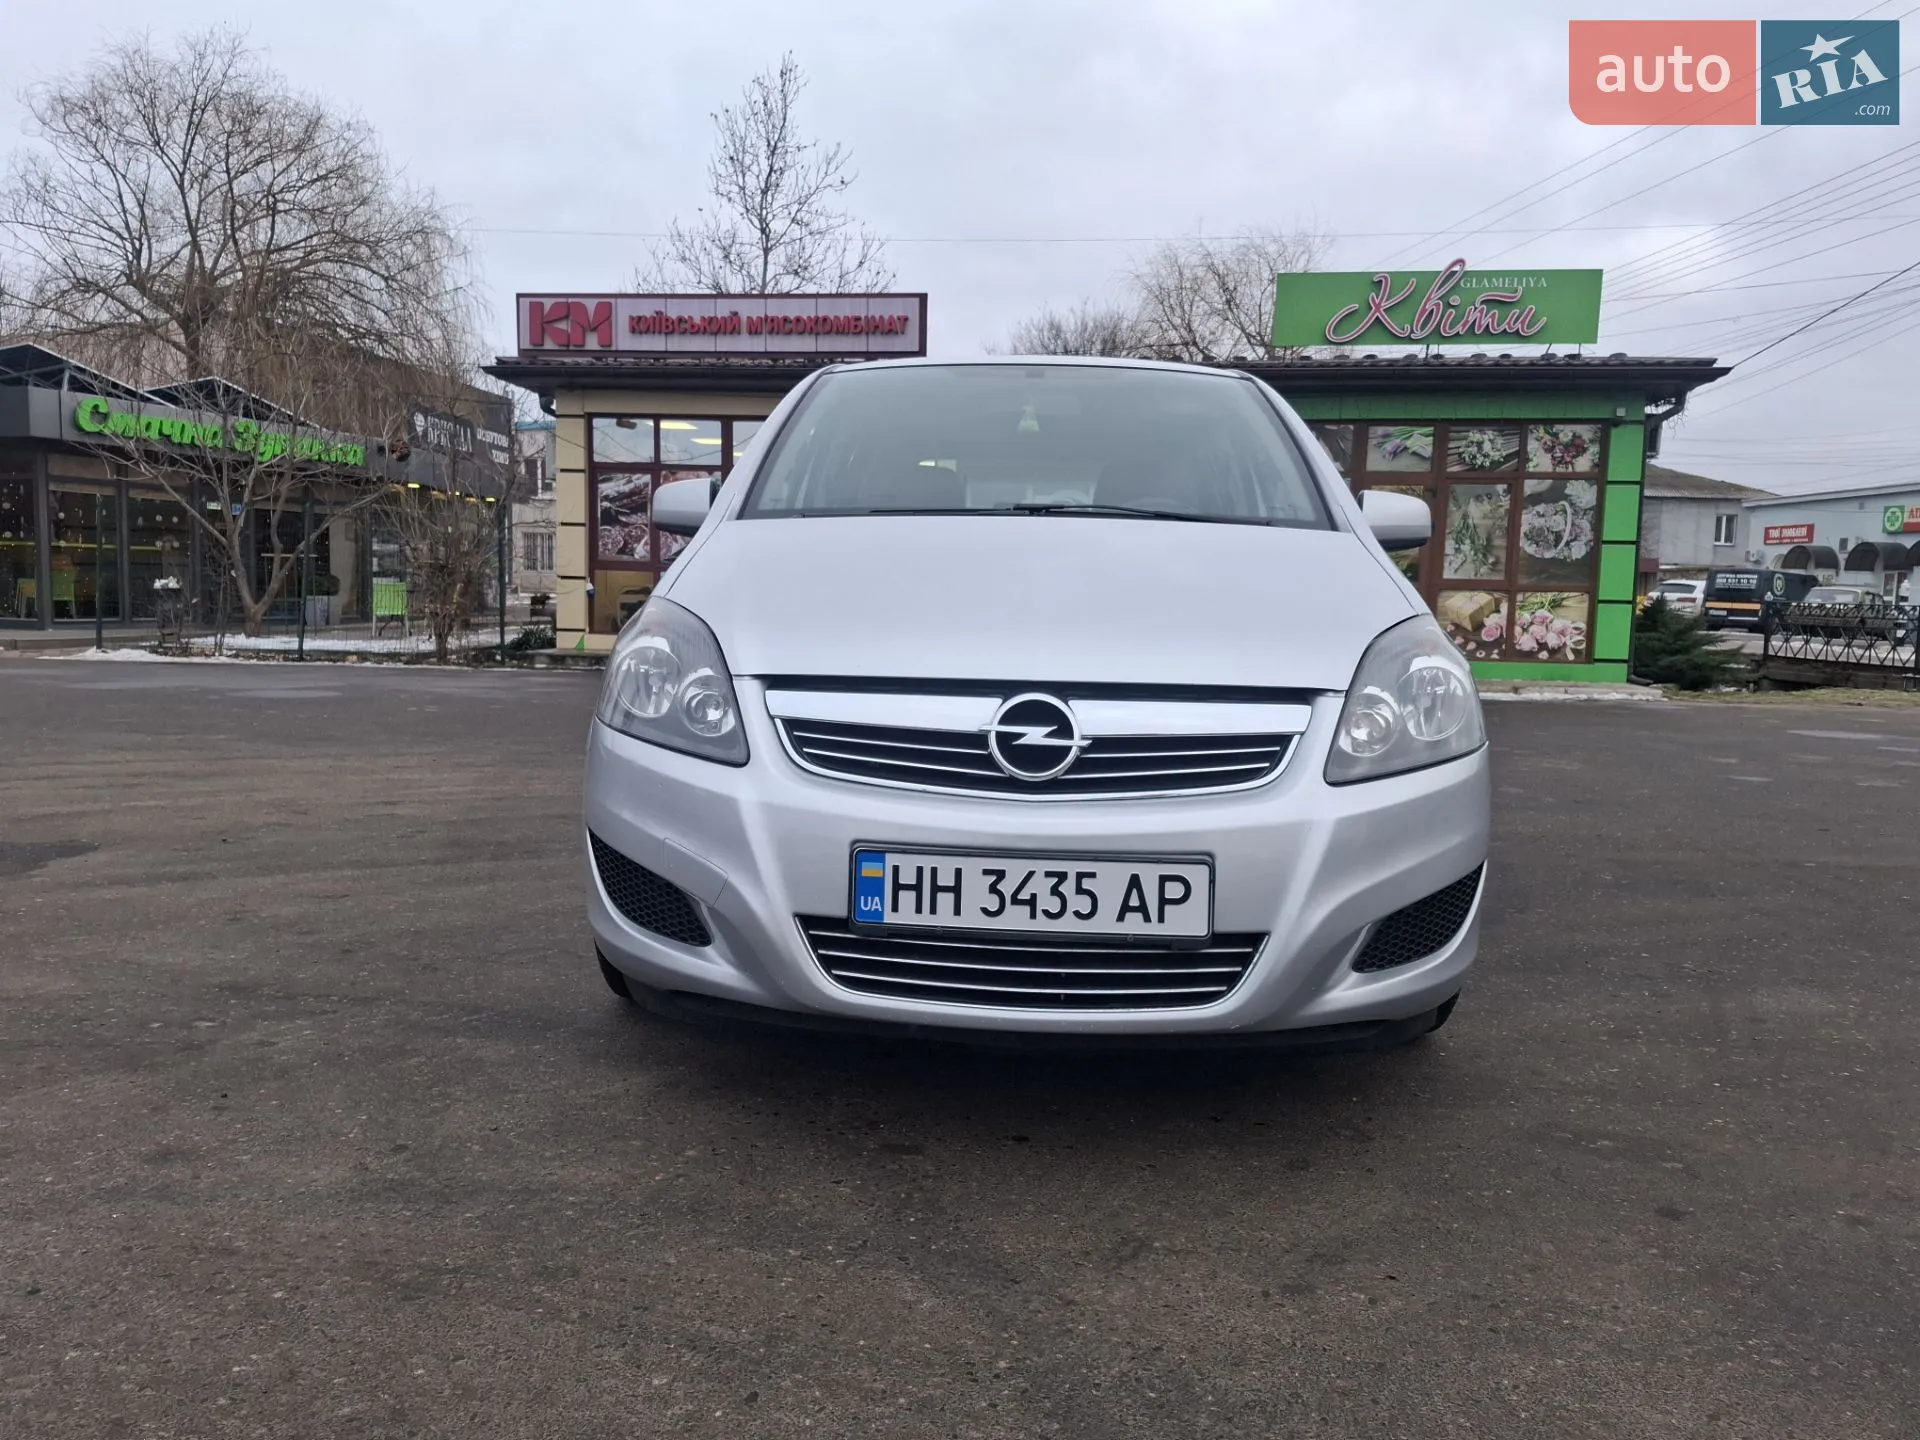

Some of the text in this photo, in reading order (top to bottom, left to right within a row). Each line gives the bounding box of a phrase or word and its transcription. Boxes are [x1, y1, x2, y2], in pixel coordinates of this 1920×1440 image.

[1325, 258, 1548, 343] Квіти
[1460, 276, 1548, 288] GLAMELIYA
[628, 310, 910, 336] КИЇВСЬКИЙ М'ЯСОКОМБІНАТ
[75, 397, 222, 449] Смачна
[860, 896, 882, 912] UA
[891, 864, 1193, 924] HH 3435 AP
